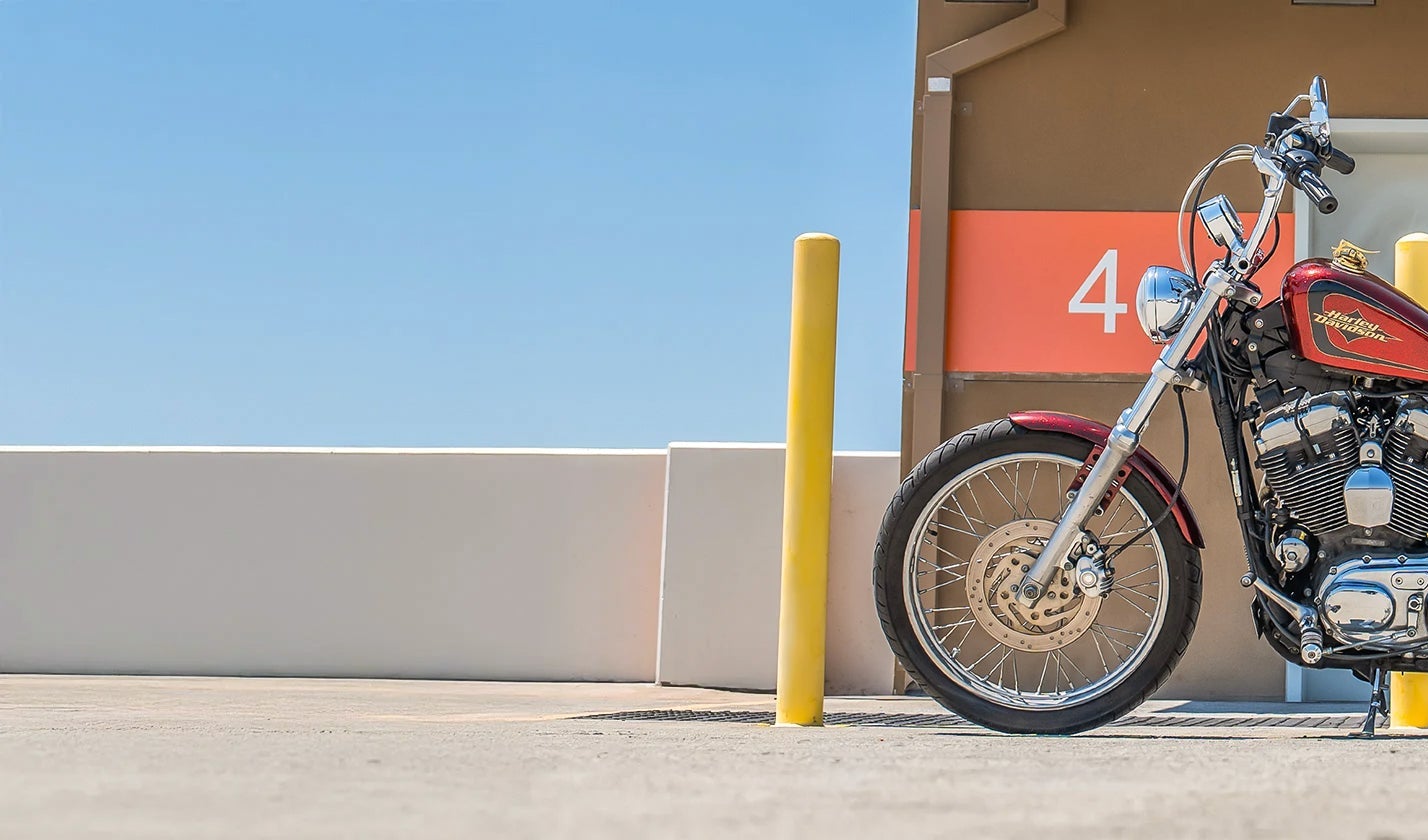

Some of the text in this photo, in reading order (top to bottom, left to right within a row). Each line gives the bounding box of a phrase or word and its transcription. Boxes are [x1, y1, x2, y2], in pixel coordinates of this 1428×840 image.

[1068, 249, 1128, 333] 4
[1313, 312, 1388, 342] Davidson
[1323, 310, 1384, 332] Harley
